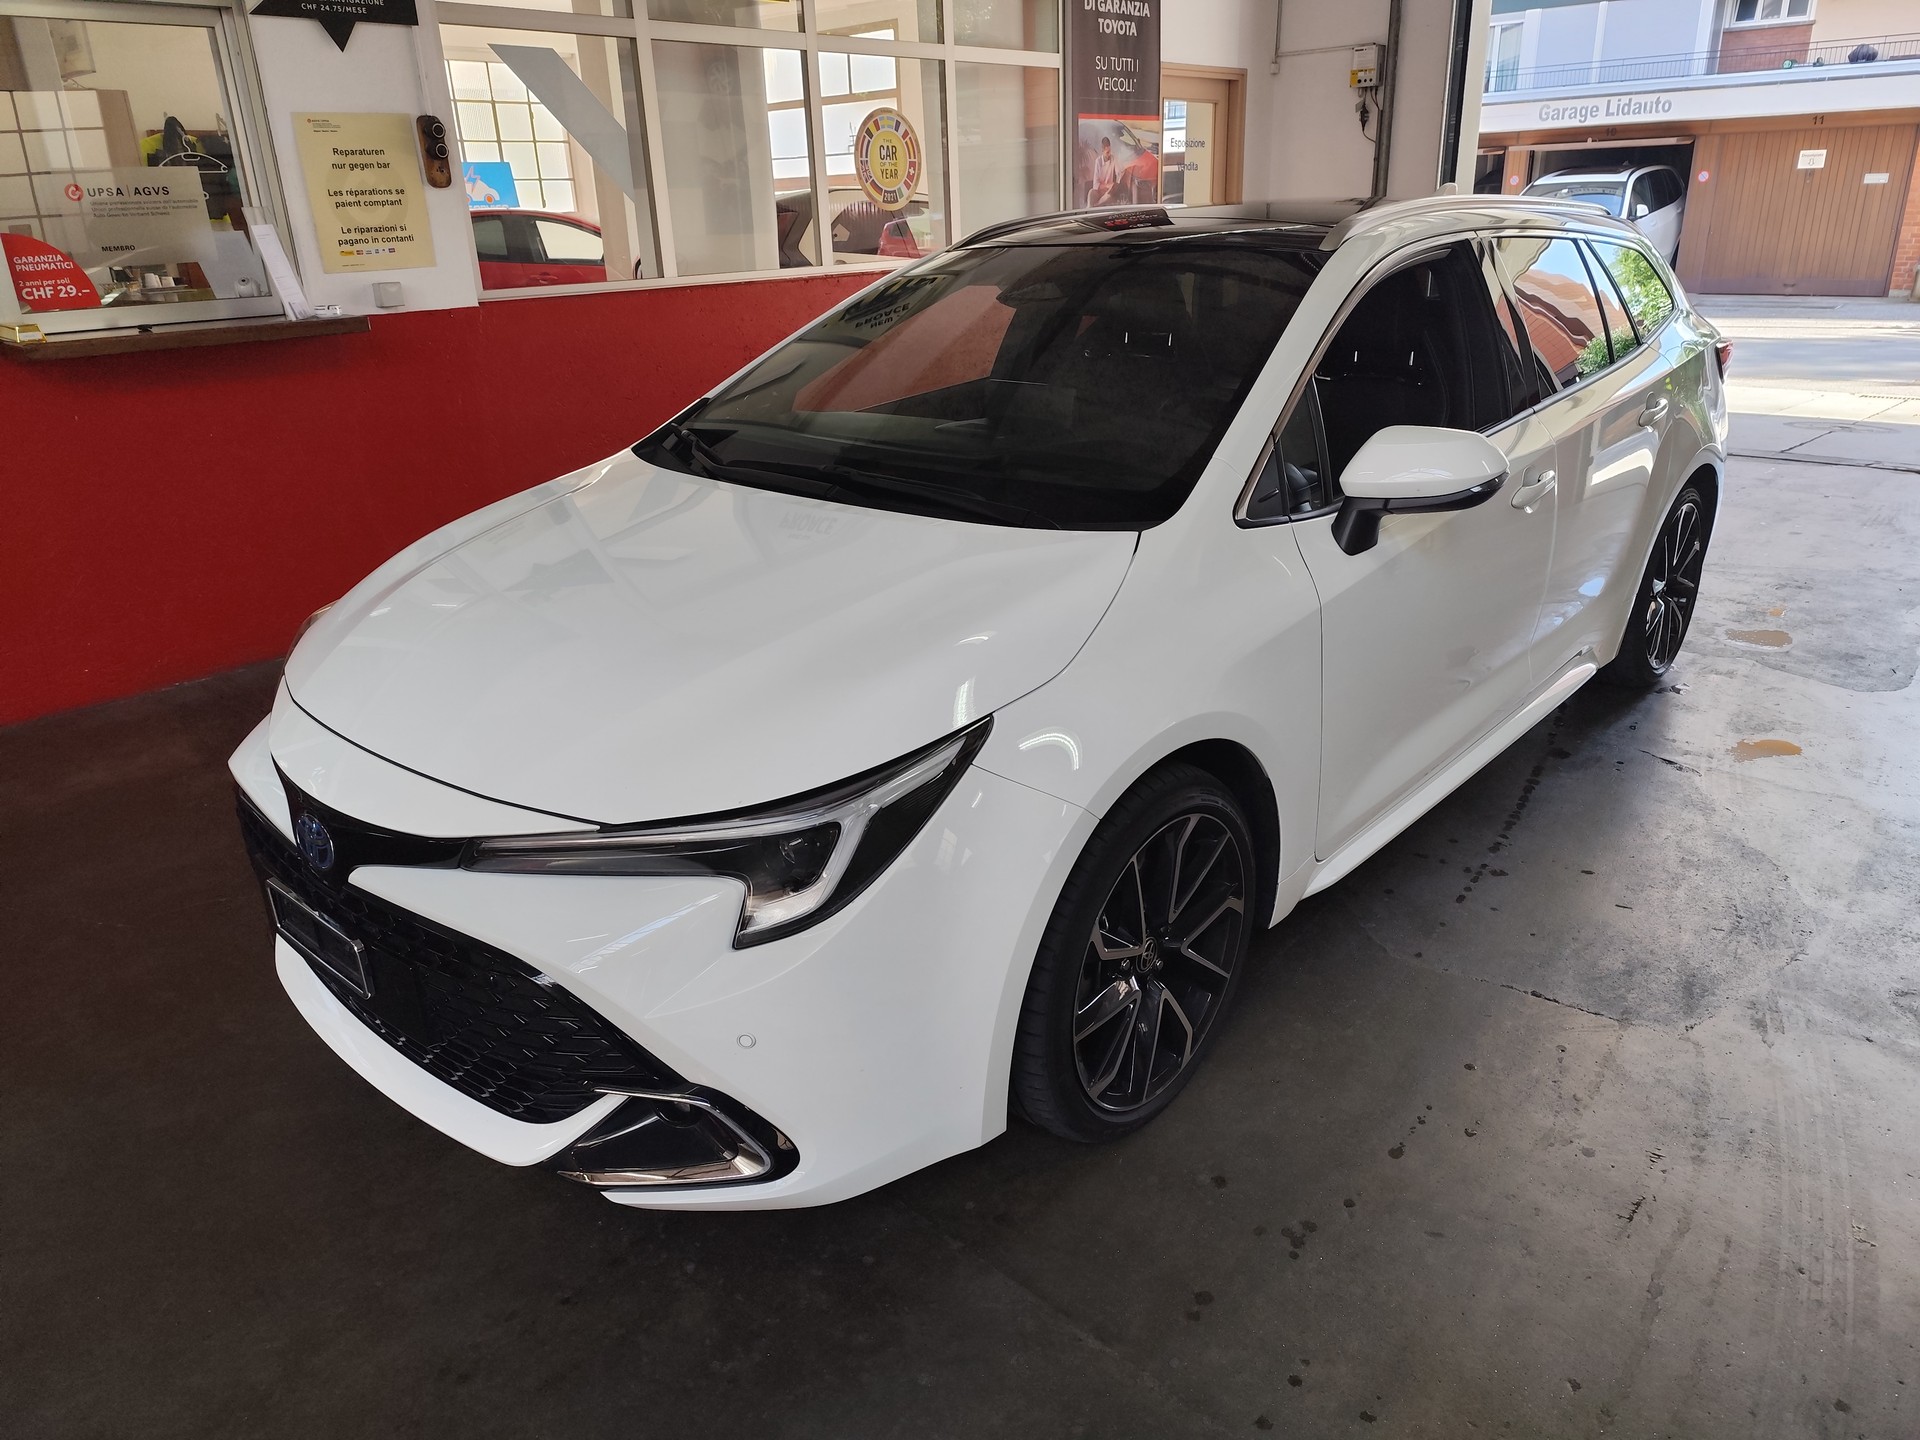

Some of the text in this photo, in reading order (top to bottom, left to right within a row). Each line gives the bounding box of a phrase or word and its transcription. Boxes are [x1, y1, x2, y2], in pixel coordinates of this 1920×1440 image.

[320, 4, 368, 14] 24.75/MESE
[1084, 0, 1150, 17] DI GARANZIA
[1098, 18, 1137, 36] TOYOTA
[1095, 55, 1108, 70] SU
[1110, 56, 1134, 72] TUTTI
[1539, 96, 1672, 123] Garage Lidauto
[1812, 115, 1825, 125] 11
[1605, 127, 1617, 137] 10
[1170, 137, 1205, 149] Esposizione
[332, 147, 385, 157] Reparaturen
[879, 144, 898, 161] CAR
[348, 162, 375, 171] gegen
[377, 161, 390, 169] bar
[880, 168, 899, 180] YEAR
[87, 186, 170, 197] UPSA AGVS
[328, 189, 343, 197] Les
[345, 187, 393, 198] réparations
[884, 192, 897, 201] 2021
[335, 198, 403, 209] paient comptant
[341, 226, 352, 234] Le
[354, 224, 398, 235] riparazioni
[338, 234, 415, 247] pagano in contanti
[101, 244, 136, 252] MEMBRO
[13, 254, 63, 264] GARANZIA
[15, 261, 74, 272] PNEUMATICI
[43, 279, 55, 288] per
[56, 277, 71, 285] soli
[21, 286, 54, 300] CHF
